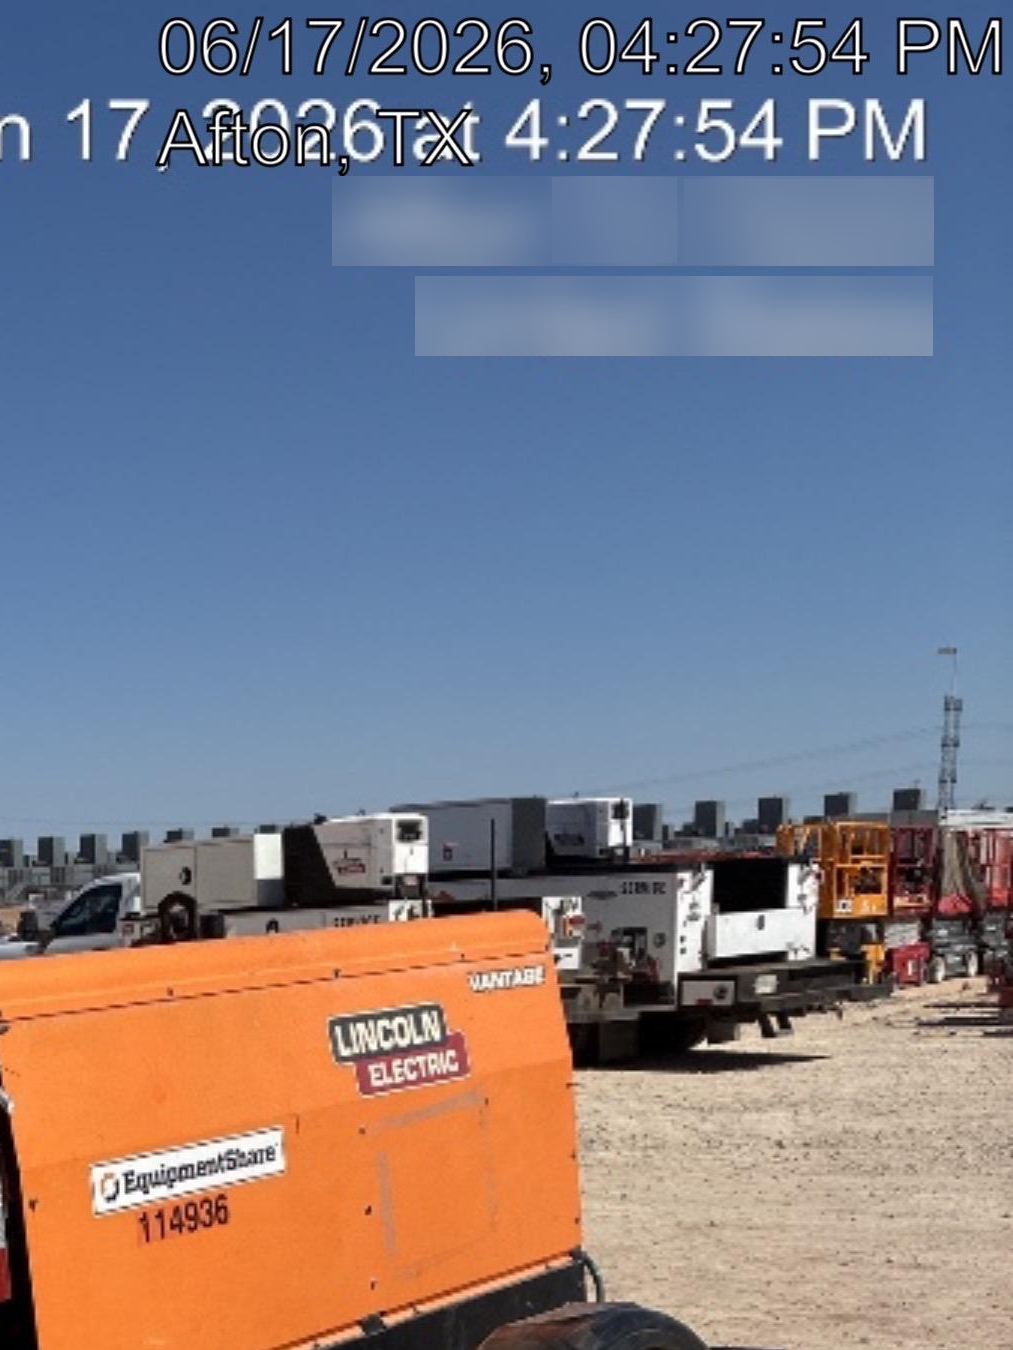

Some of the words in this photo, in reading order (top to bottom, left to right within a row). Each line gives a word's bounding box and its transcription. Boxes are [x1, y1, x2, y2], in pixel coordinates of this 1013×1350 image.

[469, 965, 546, 993] VANTAGE
[334, 1009, 443, 1057] LINCOLN
[367, 1049, 460, 1088] ELECTRIC
[122, 1145, 277, 1196] EquipmentShare
[139, 1194, 229, 1243] 114936
